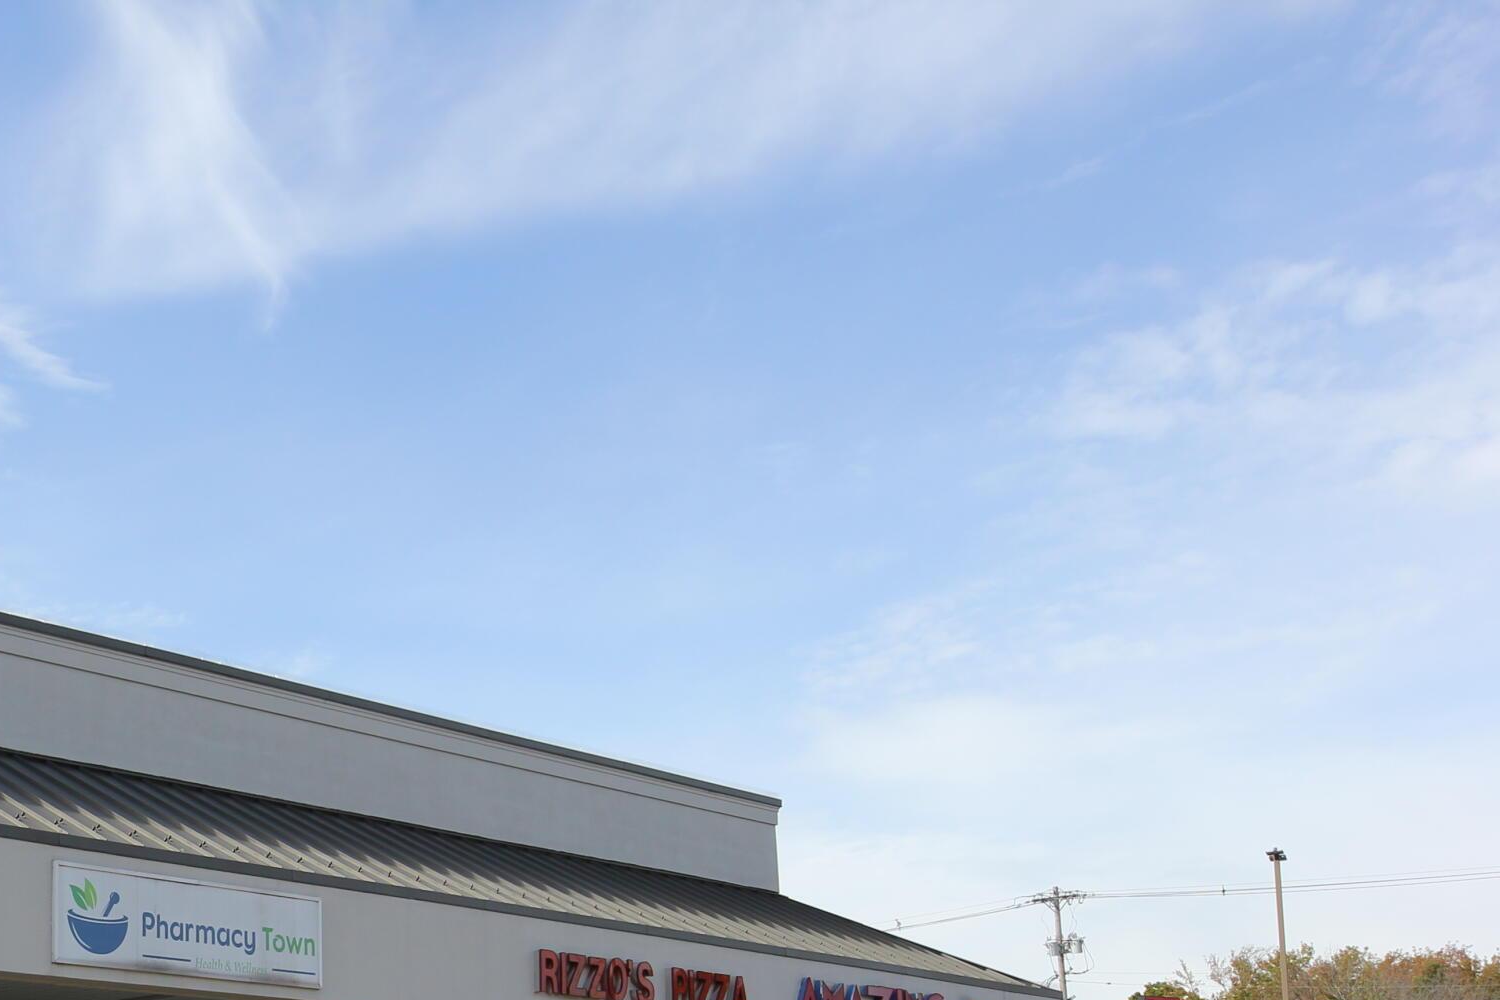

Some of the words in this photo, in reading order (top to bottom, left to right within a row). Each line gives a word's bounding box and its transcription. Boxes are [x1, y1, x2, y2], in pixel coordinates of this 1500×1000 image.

[142, 911, 257, 955] Pharmacy
[262, 927, 316, 956] Town
[195, 957, 223, 970] Health
